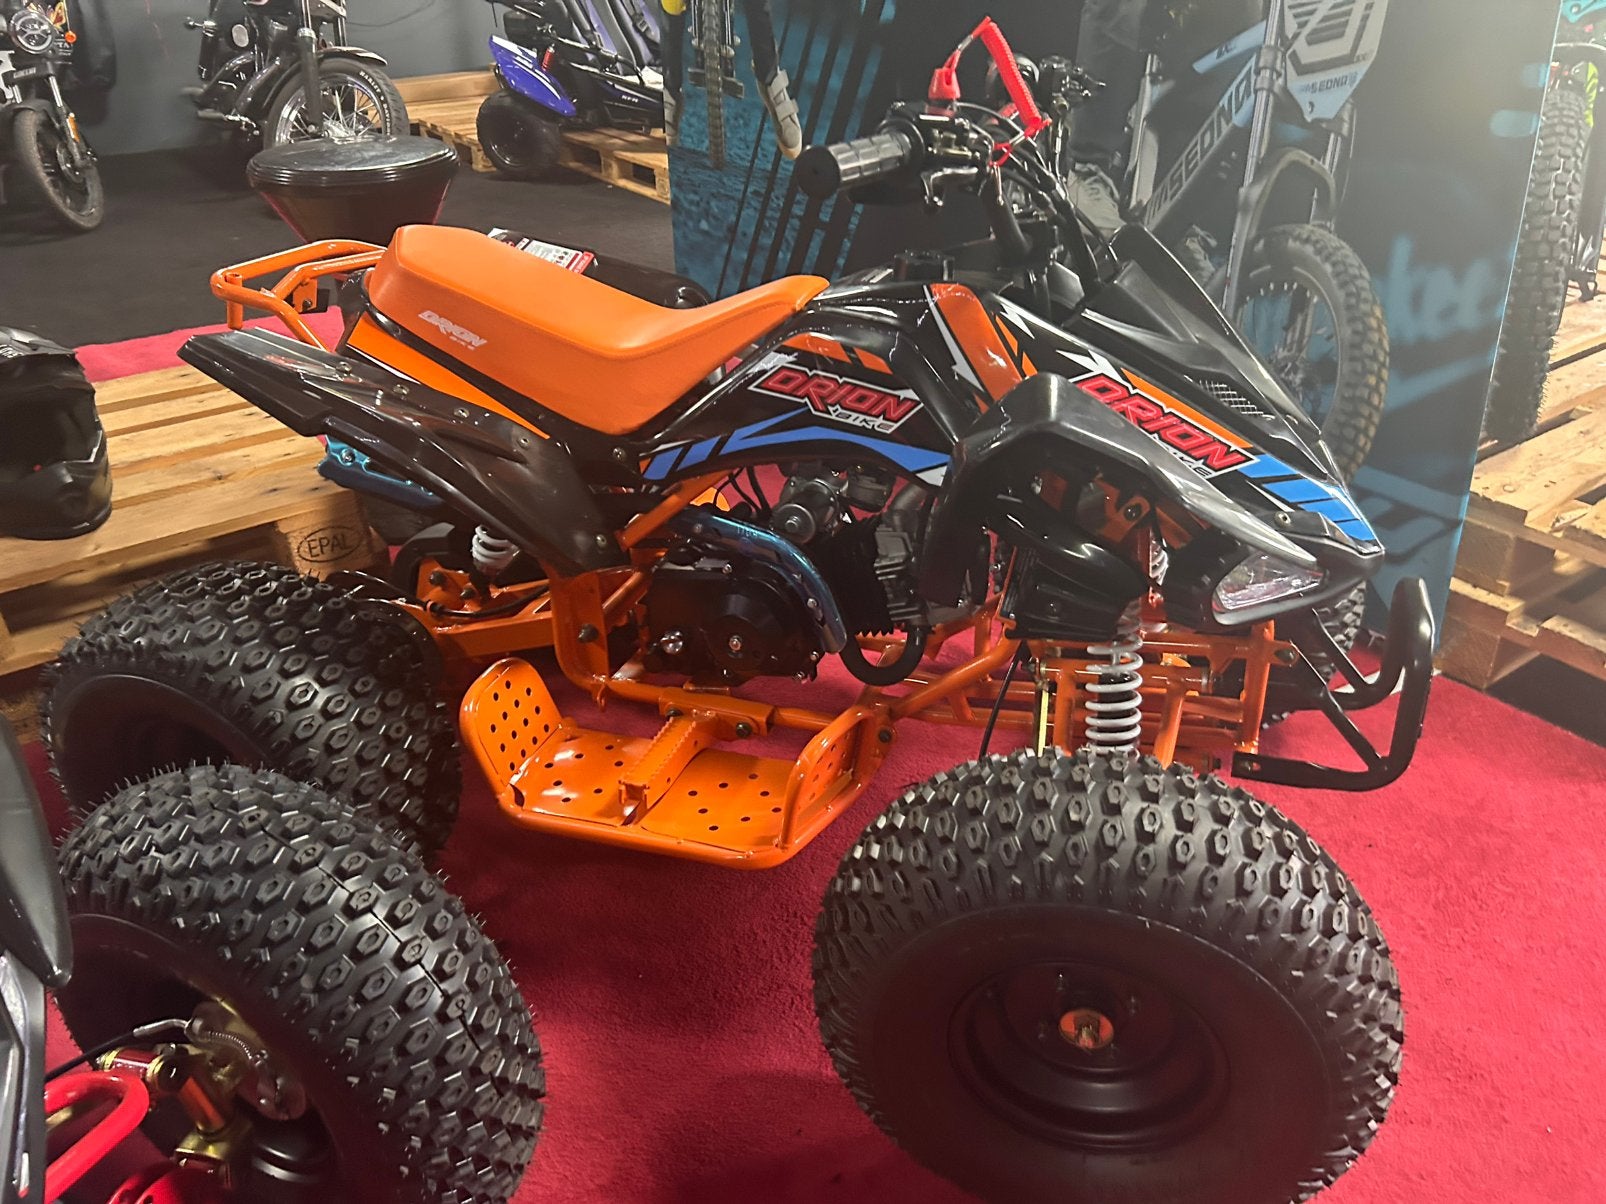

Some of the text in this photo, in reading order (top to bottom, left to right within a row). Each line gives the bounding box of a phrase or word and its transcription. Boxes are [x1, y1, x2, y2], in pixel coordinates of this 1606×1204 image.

[359, 71, 381, 92] HARLEY
[418, 310, 487, 347] ORION
[760, 367, 917, 422] ORION
[835, 411, 894, 430] BIKE
[1076, 375, 1247, 470] ORION
[308, 533, 352, 558] EPAL
